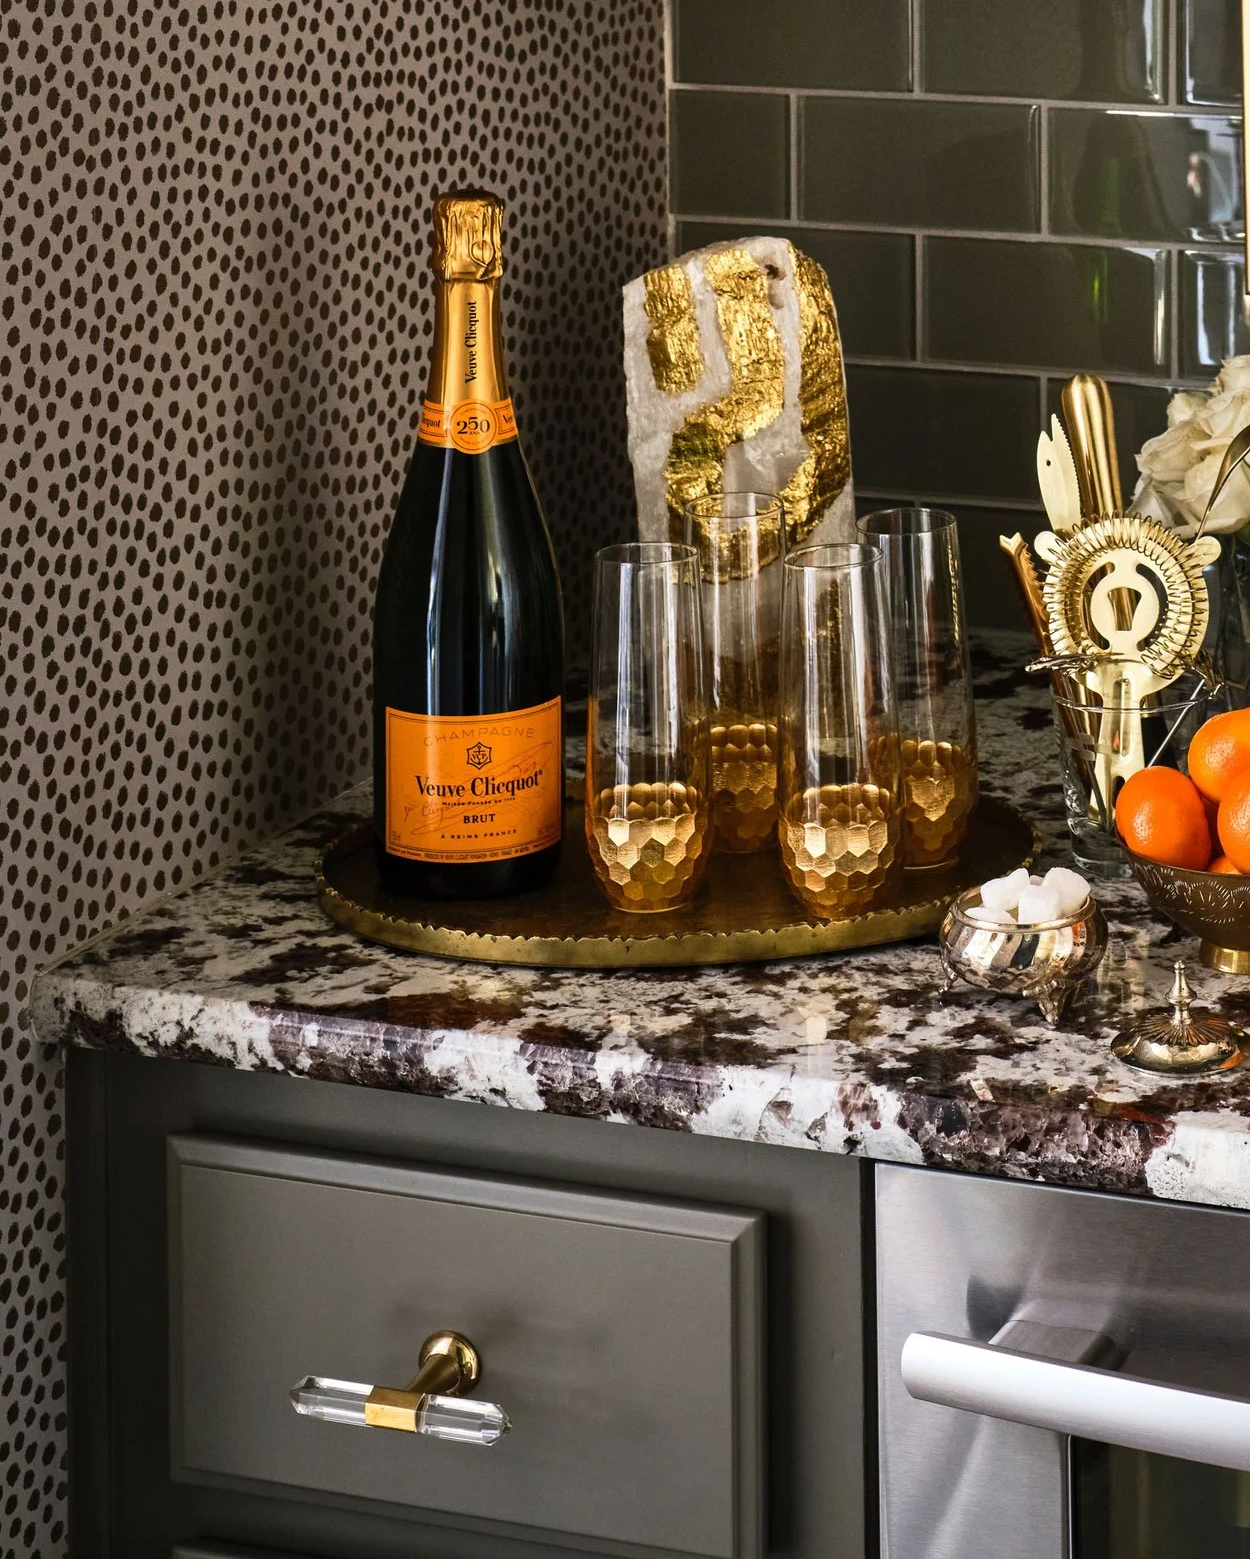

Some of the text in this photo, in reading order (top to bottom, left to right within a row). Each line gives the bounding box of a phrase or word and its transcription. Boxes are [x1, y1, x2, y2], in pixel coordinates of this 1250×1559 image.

[464, 300, 480, 384] Veuve Clicquot
[456, 416, 491, 435] 250
[424, 726, 536, 747] CHAMPAGNE
[415, 775, 465, 797] Veuve
[463, 813, 496, 824] BRUT
[484, 829, 517, 838] FRANCE
